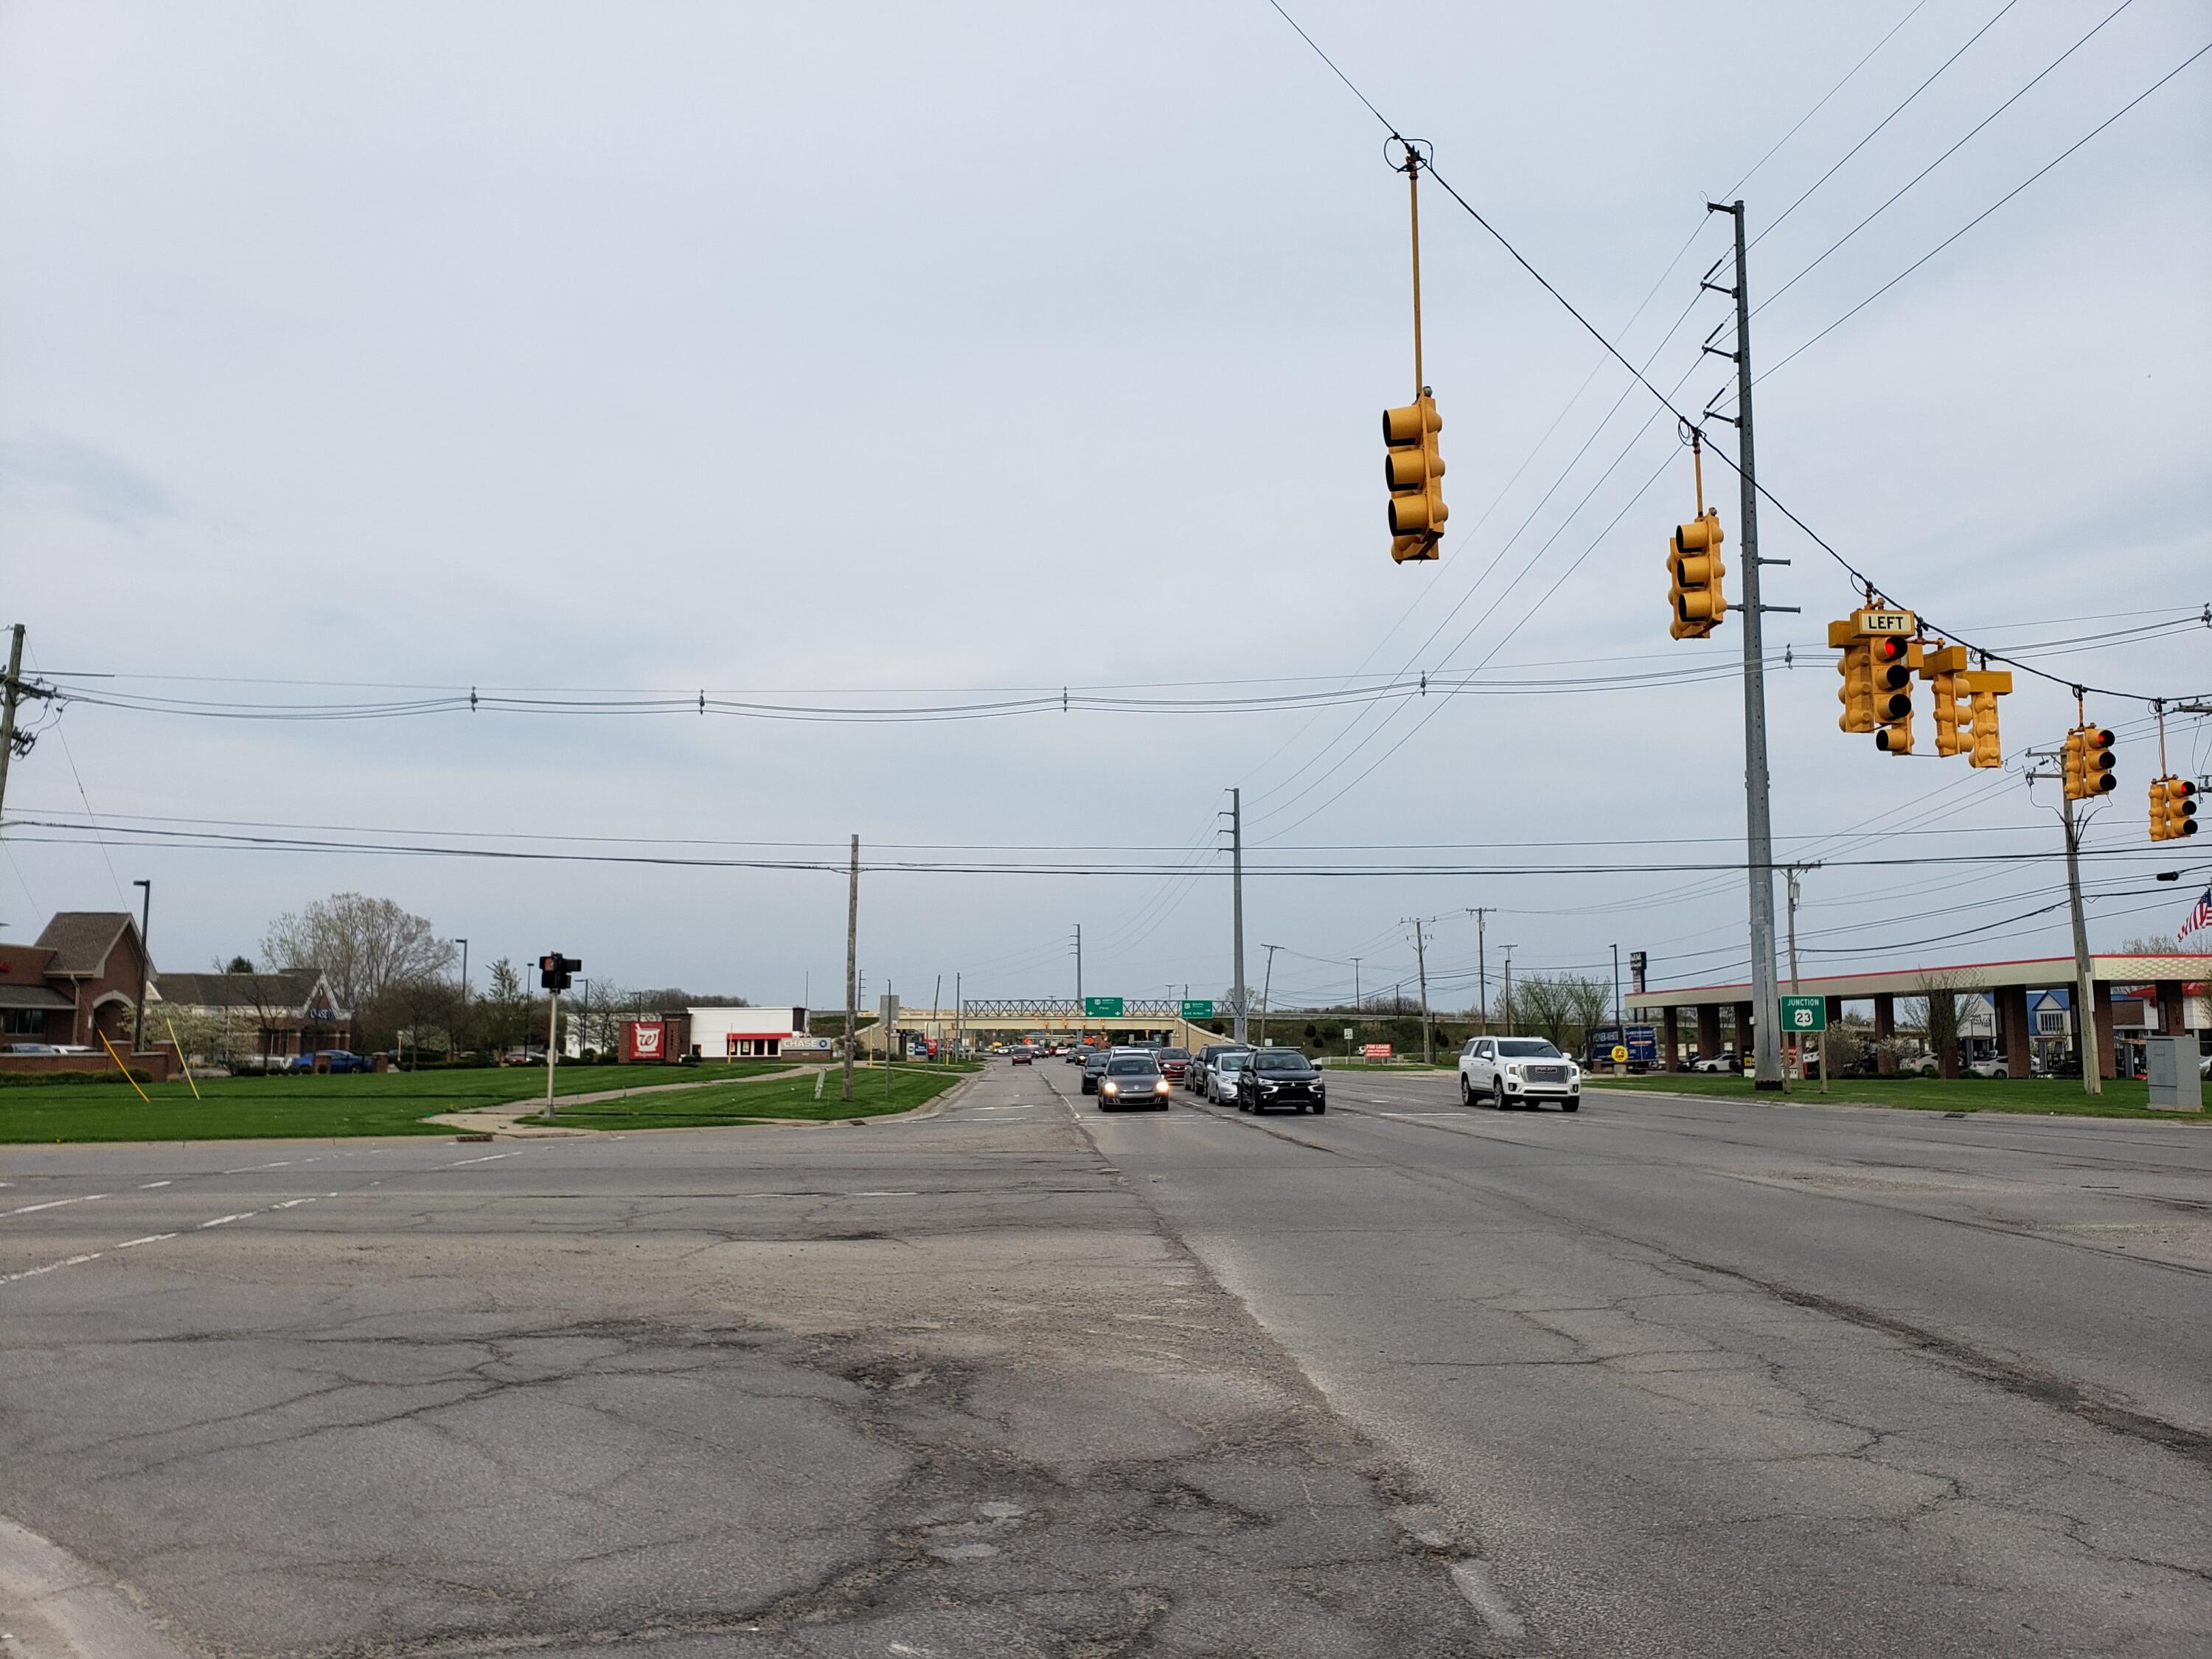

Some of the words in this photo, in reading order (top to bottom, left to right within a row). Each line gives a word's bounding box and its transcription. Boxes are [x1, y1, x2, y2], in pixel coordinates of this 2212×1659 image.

[1868, 616, 1904, 630] LEFT
[1787, 998, 1820, 1006] JUNCTION
[1796, 1012, 1811, 1023] 23
